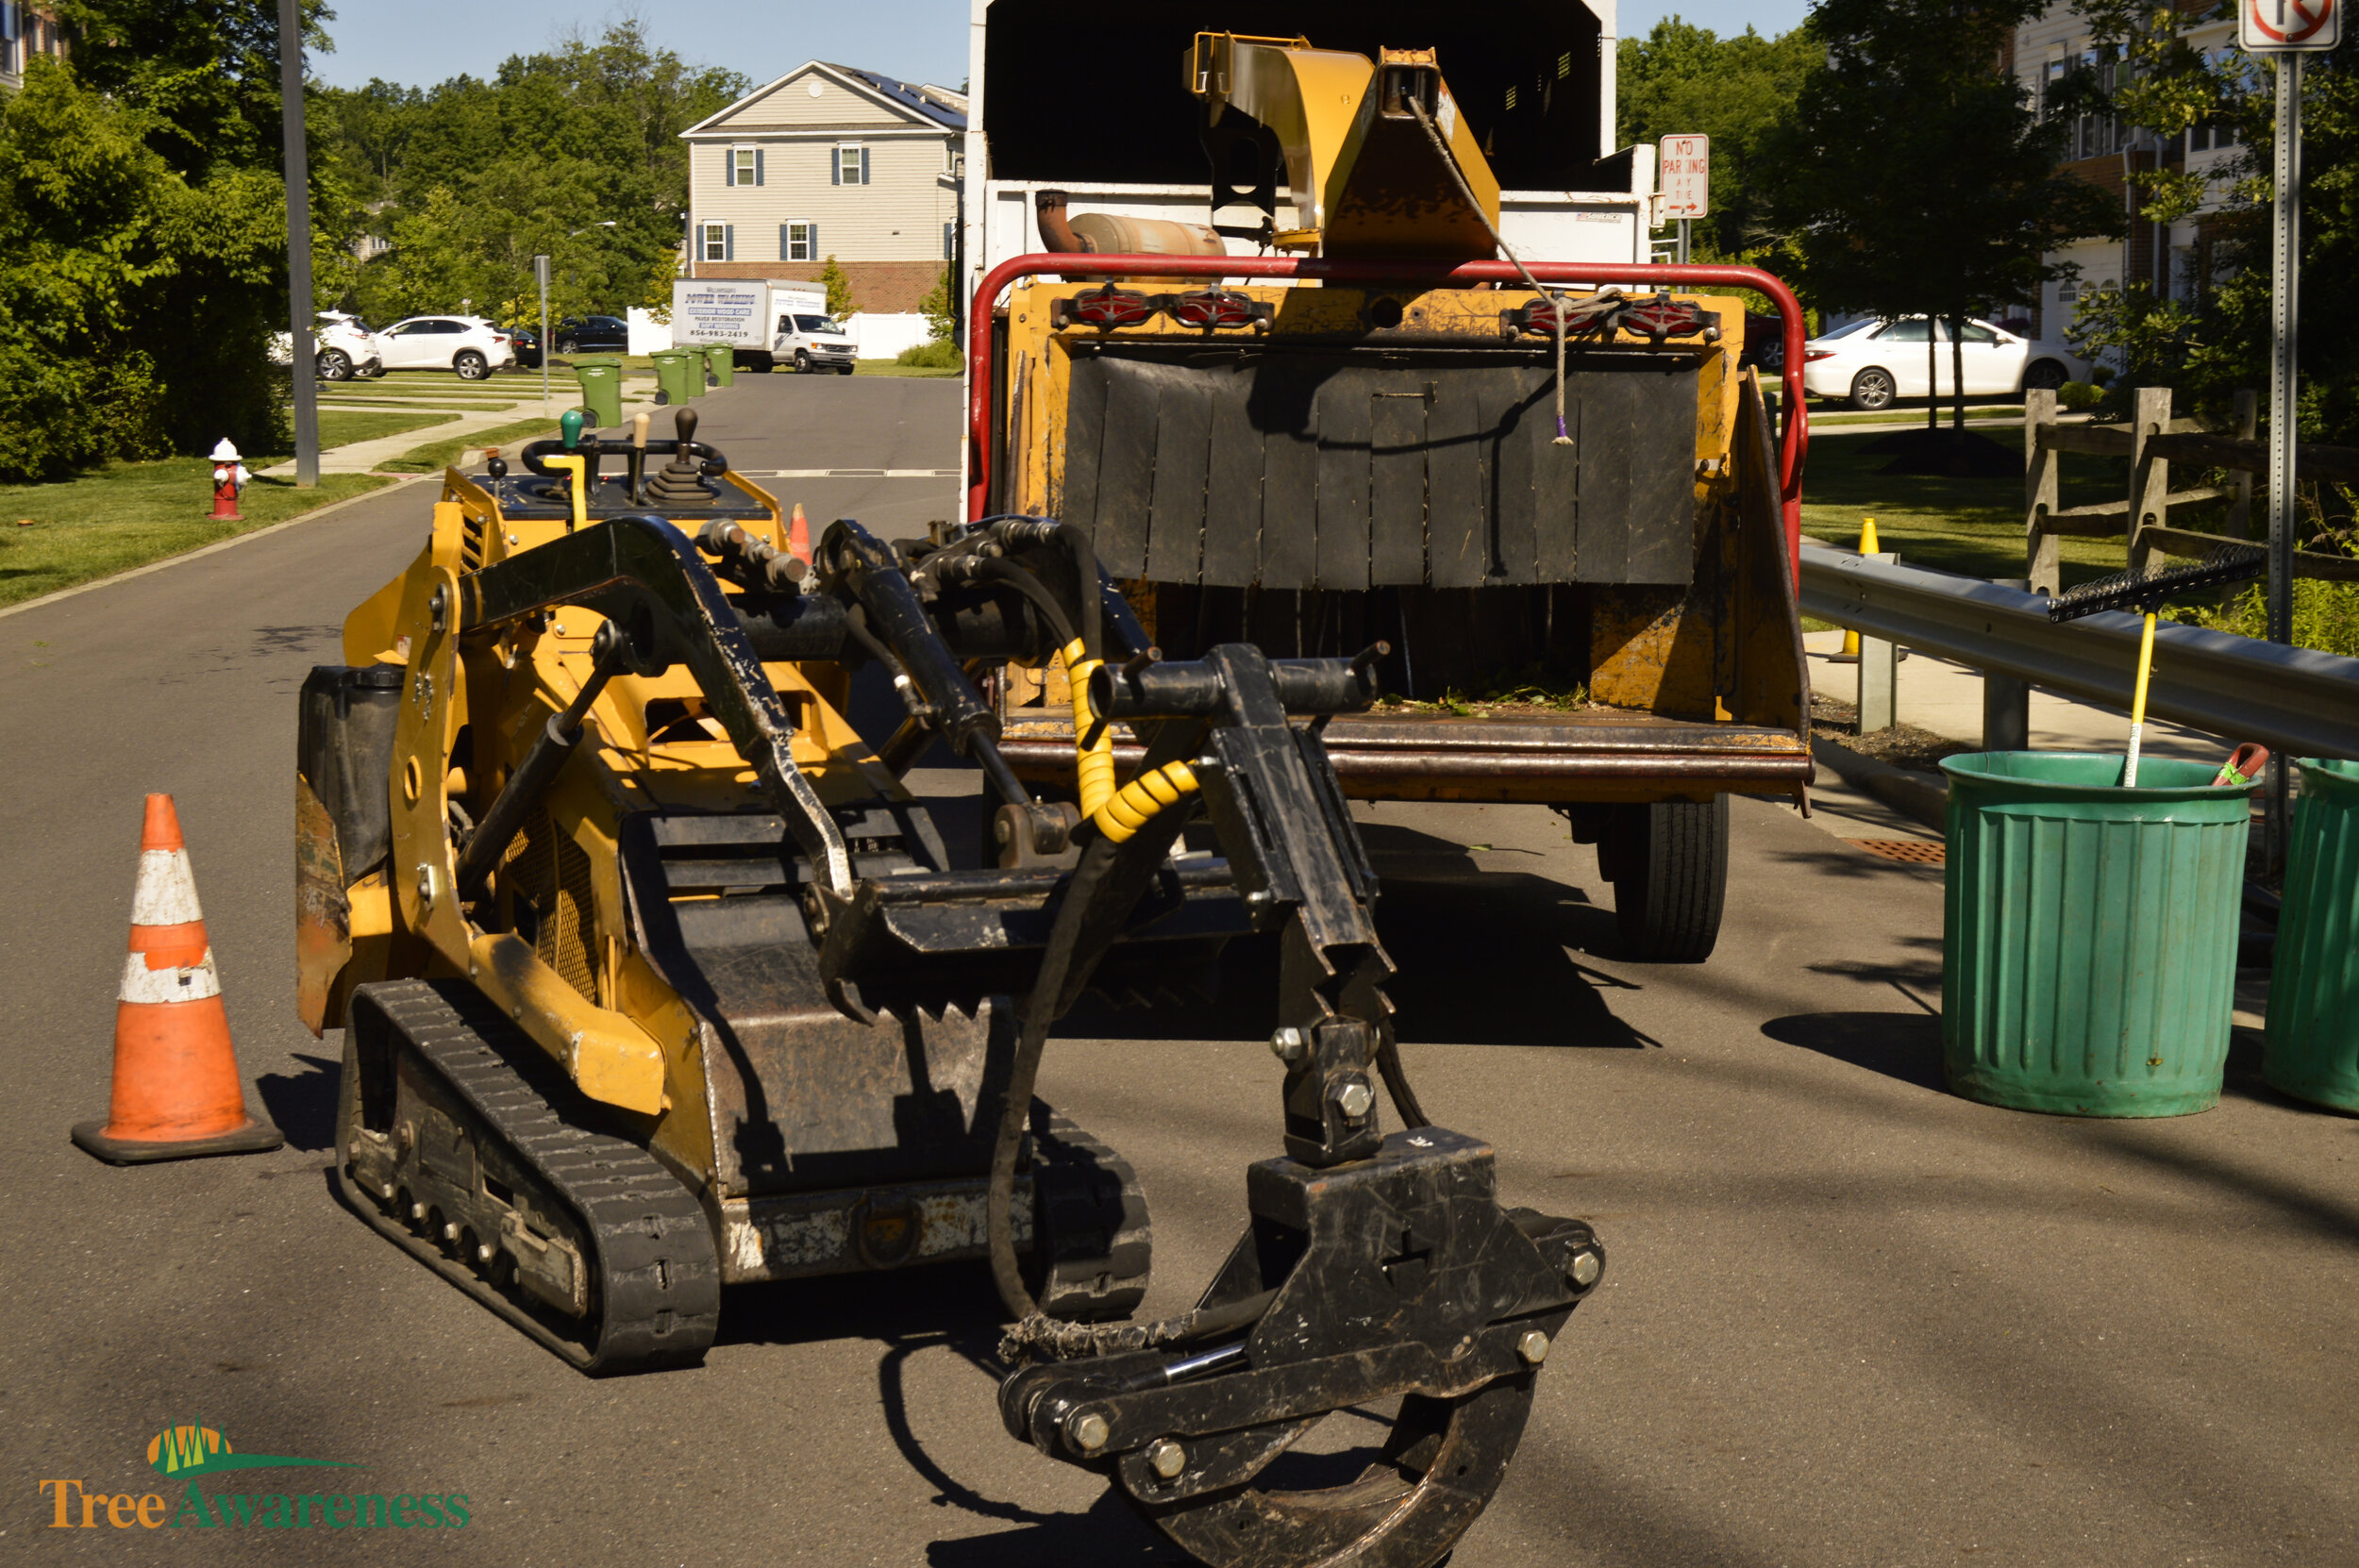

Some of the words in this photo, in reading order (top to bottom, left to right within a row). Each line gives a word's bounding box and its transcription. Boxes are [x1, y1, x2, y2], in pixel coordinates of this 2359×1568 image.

[1676, 141, 1694, 156] NO
[1664, 158, 1706, 175] PARING
[1676, 177, 1692, 188] AY
[685, 293, 714, 304] POWER
[717, 294, 755, 305] WASHING
